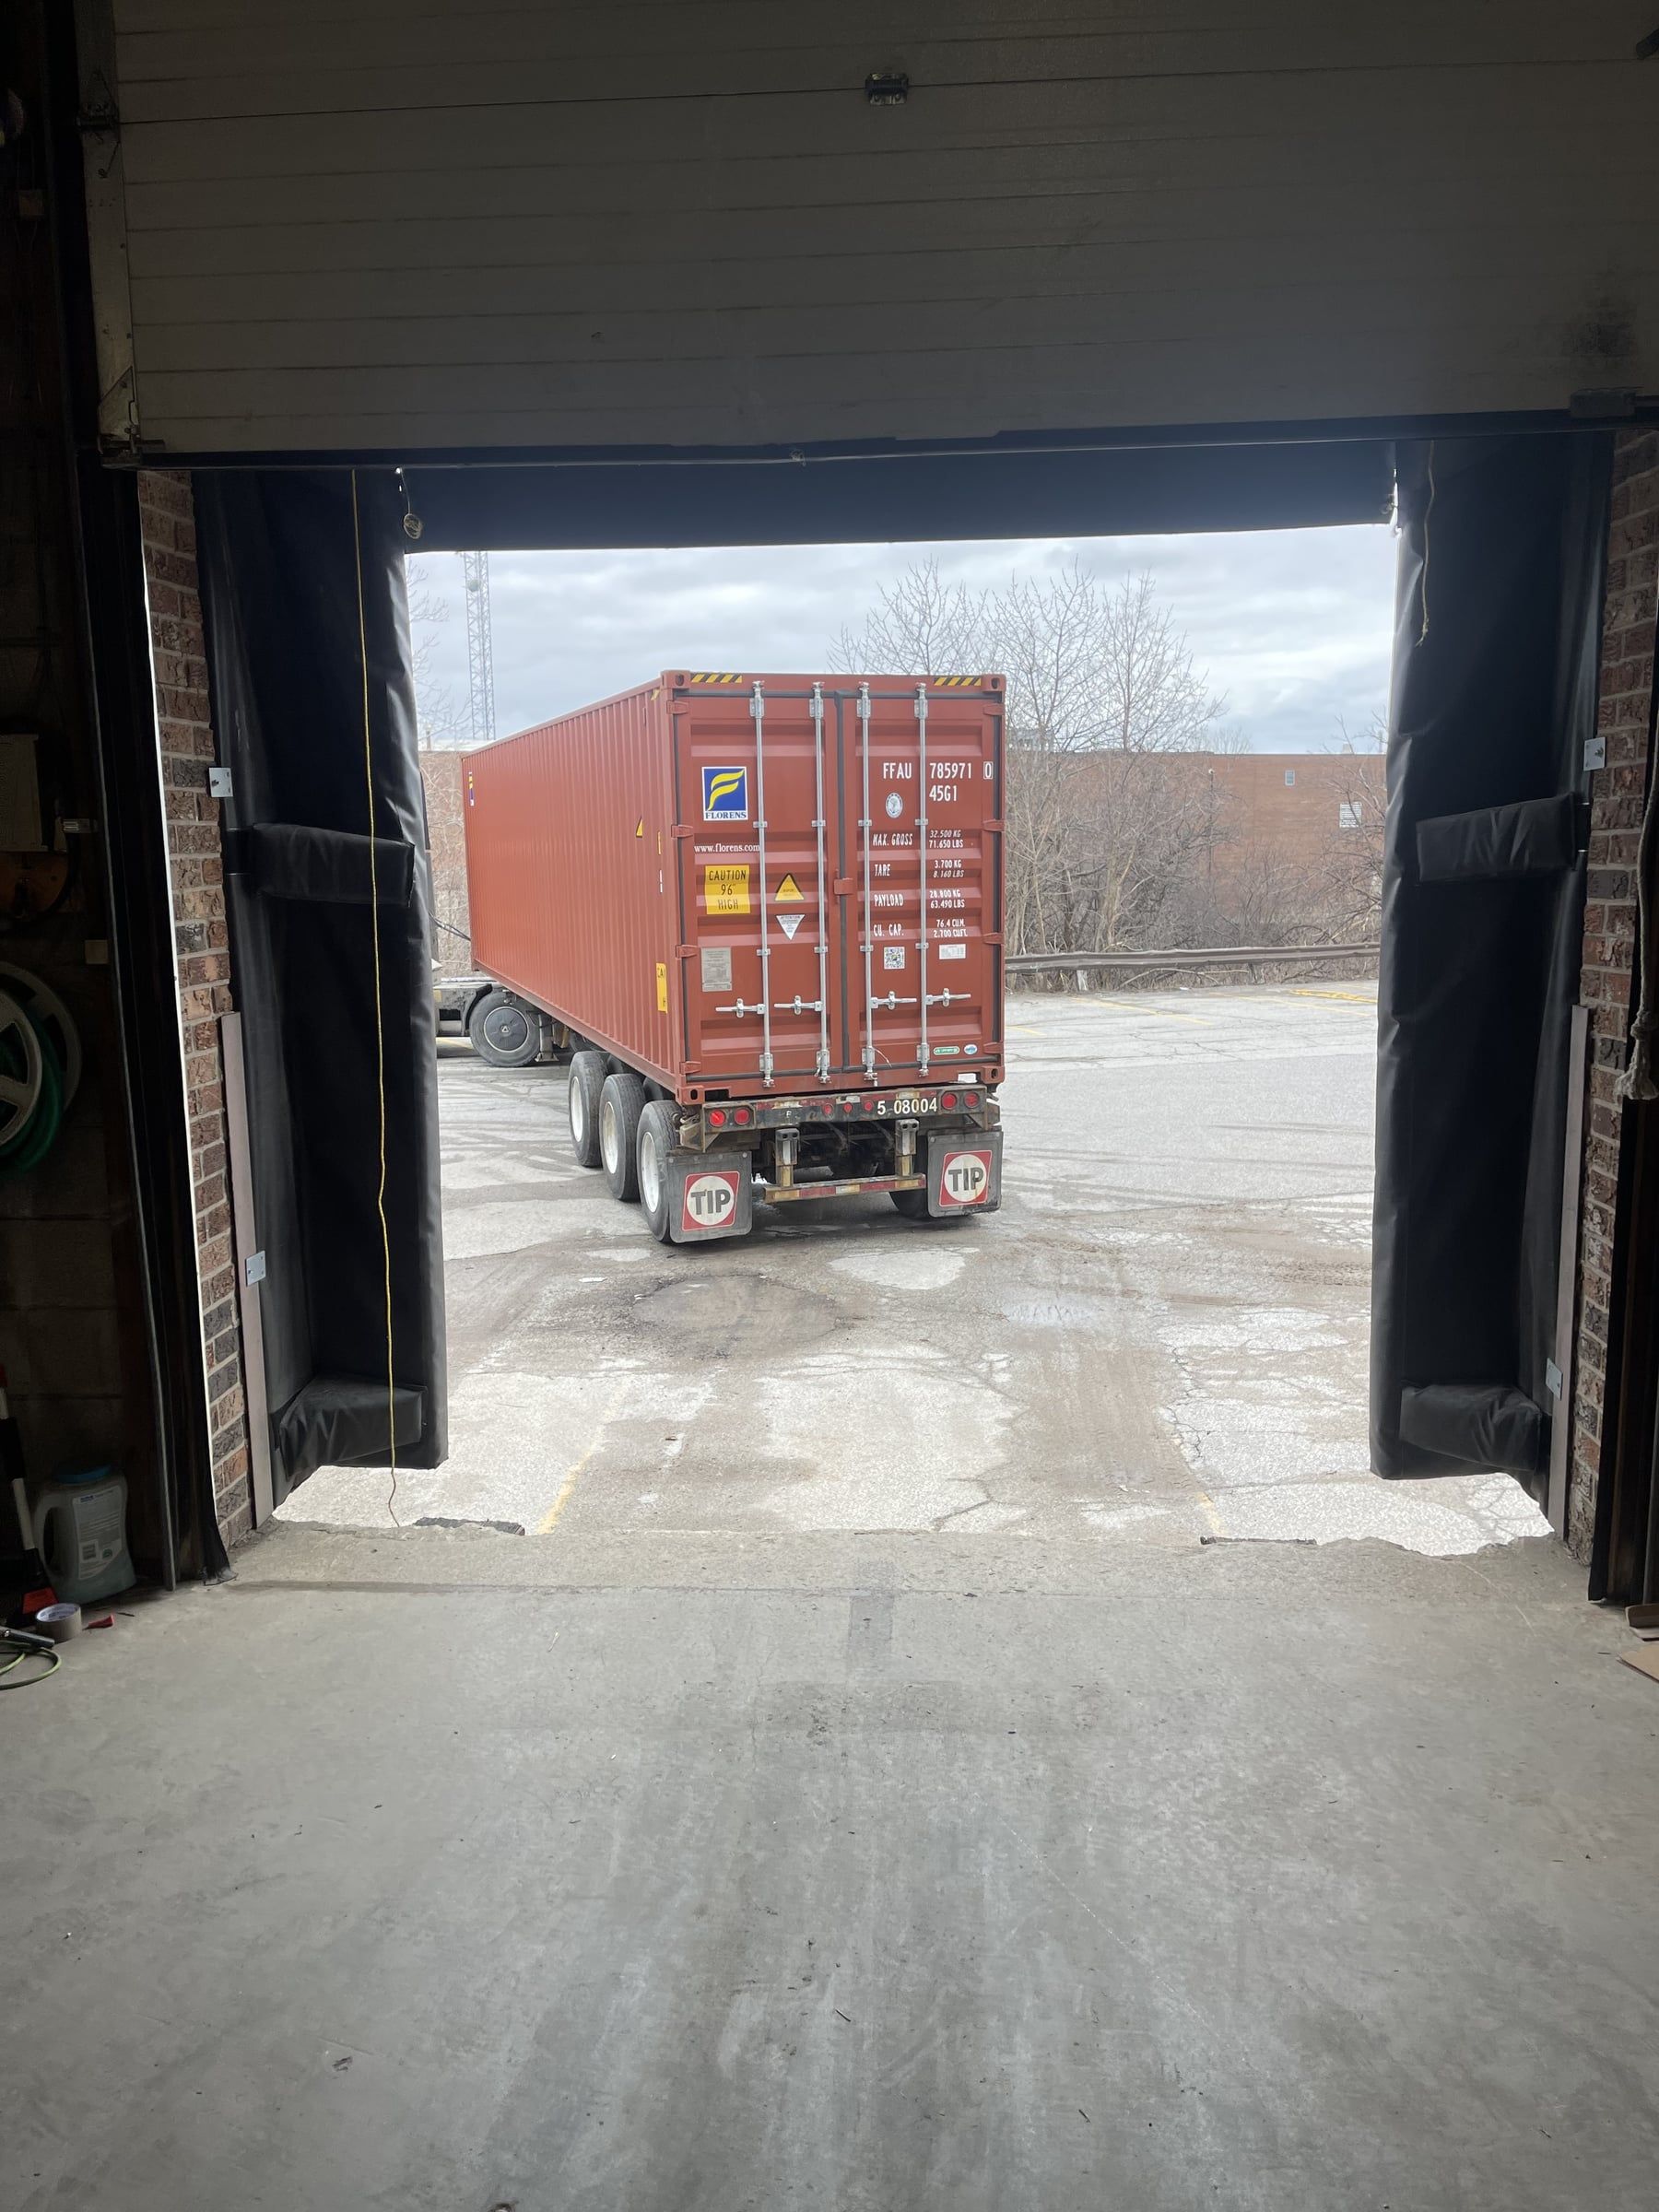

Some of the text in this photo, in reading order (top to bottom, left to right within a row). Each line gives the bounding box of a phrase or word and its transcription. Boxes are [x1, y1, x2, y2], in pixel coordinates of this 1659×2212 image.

[883, 761, 993, 779] FFAU 785971 0
[929, 785, 958, 802] 45G1
[705, 811, 747, 819] FLORENS
[873, 833, 913, 846] MAX. GROSS
[953, 830, 961, 838] KG
[694, 843, 760, 854] www.florens.com
[929, 840, 964, 848] 71.650 LBS
[935, 859, 962, 868] 3.700 KG
[709, 869, 747, 881] CAUTION
[875, 864, 890, 877] TARE
[934, 870, 951, 878] 8.160
[953, 889, 961, 899] KG
[717, 900, 738, 911] HIGH
[875, 893, 903, 907] PAYLOAD
[931, 900, 965, 909] 63.490 LBS
[936, 919, 950, 928] 76.4
[874, 924, 904, 937] CU. CAP.
[934, 929, 952, 938] 2.700
[877, 1097, 937, 1115] 5 08004
[947, 1168, 984, 1192] TIP
[690, 1188, 731, 1215] TIP
